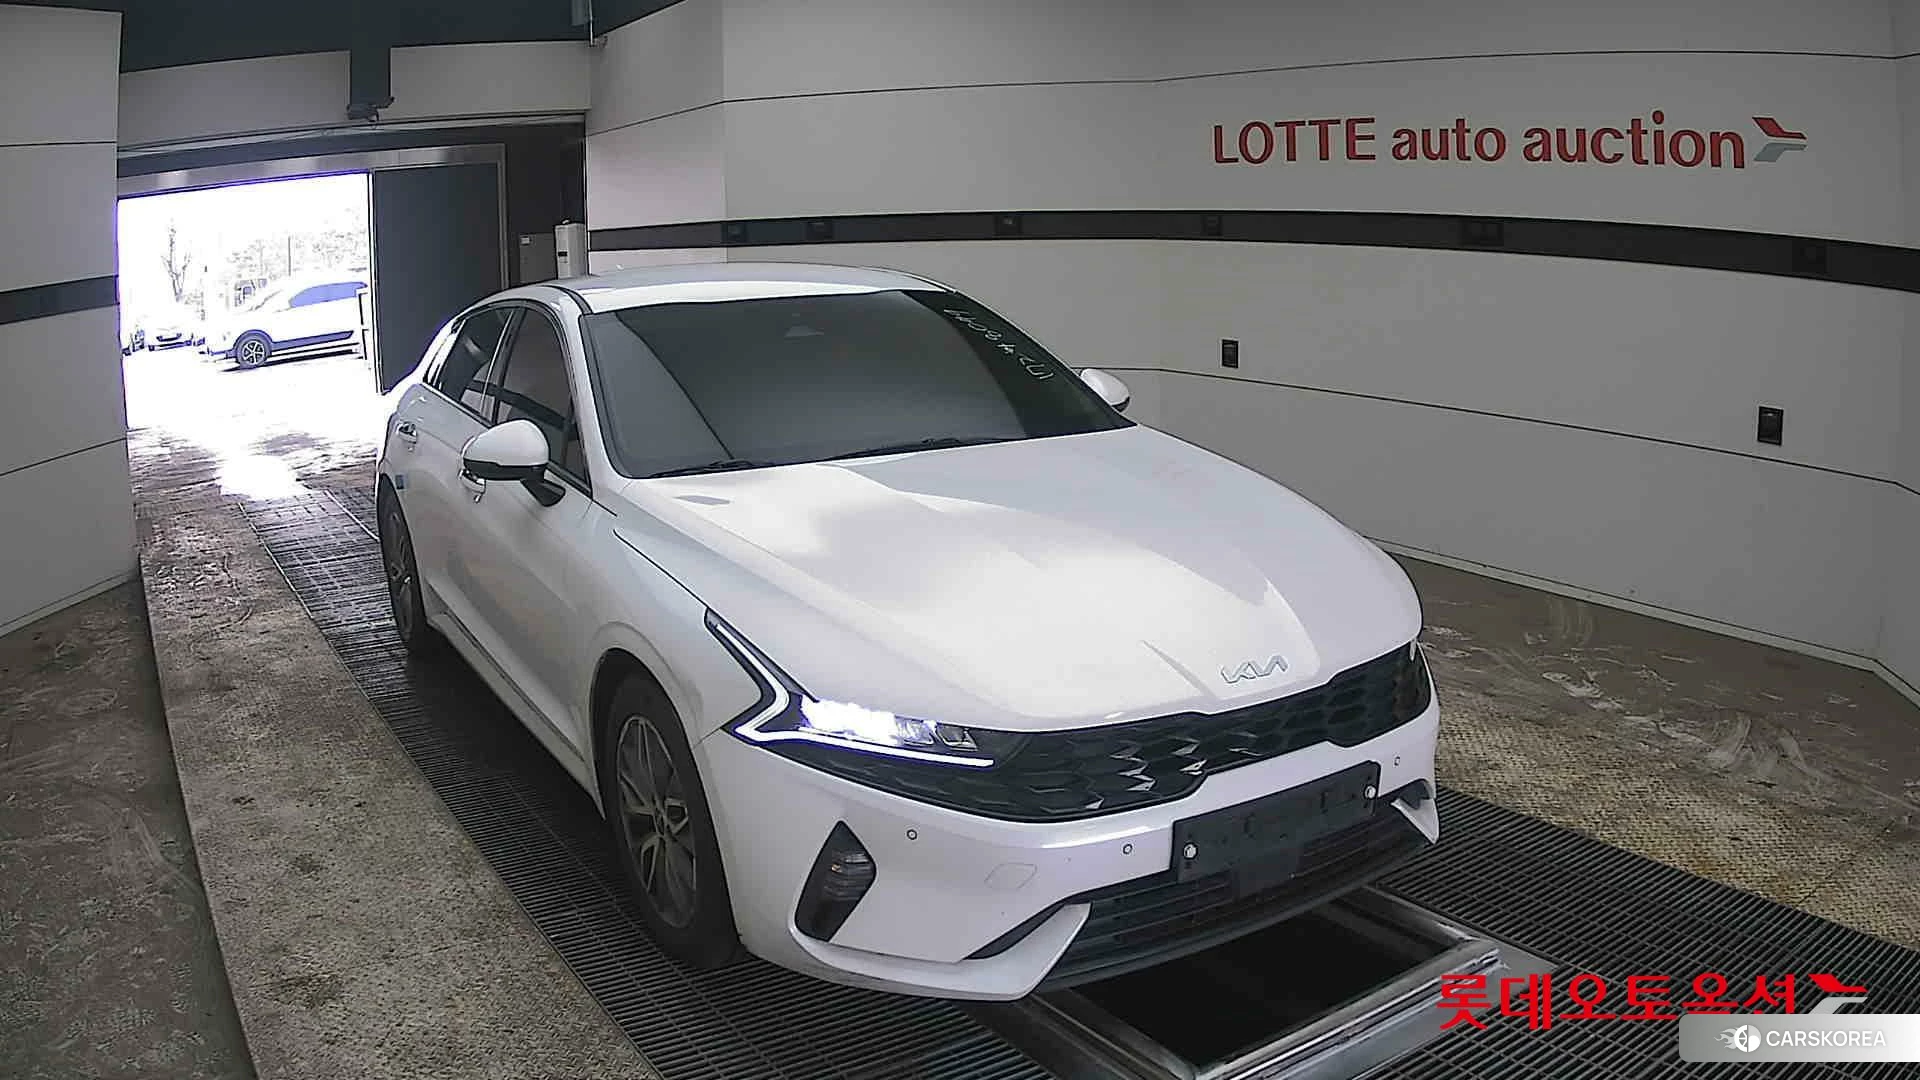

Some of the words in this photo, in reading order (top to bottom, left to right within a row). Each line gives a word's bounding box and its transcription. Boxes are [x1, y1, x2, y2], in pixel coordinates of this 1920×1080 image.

[1212, 116, 1377, 165] LOTTE
[1390, 117, 1507, 162] auto
[1521, 109, 1747, 169] auction
[1220, 654, 1289, 684] KIA
